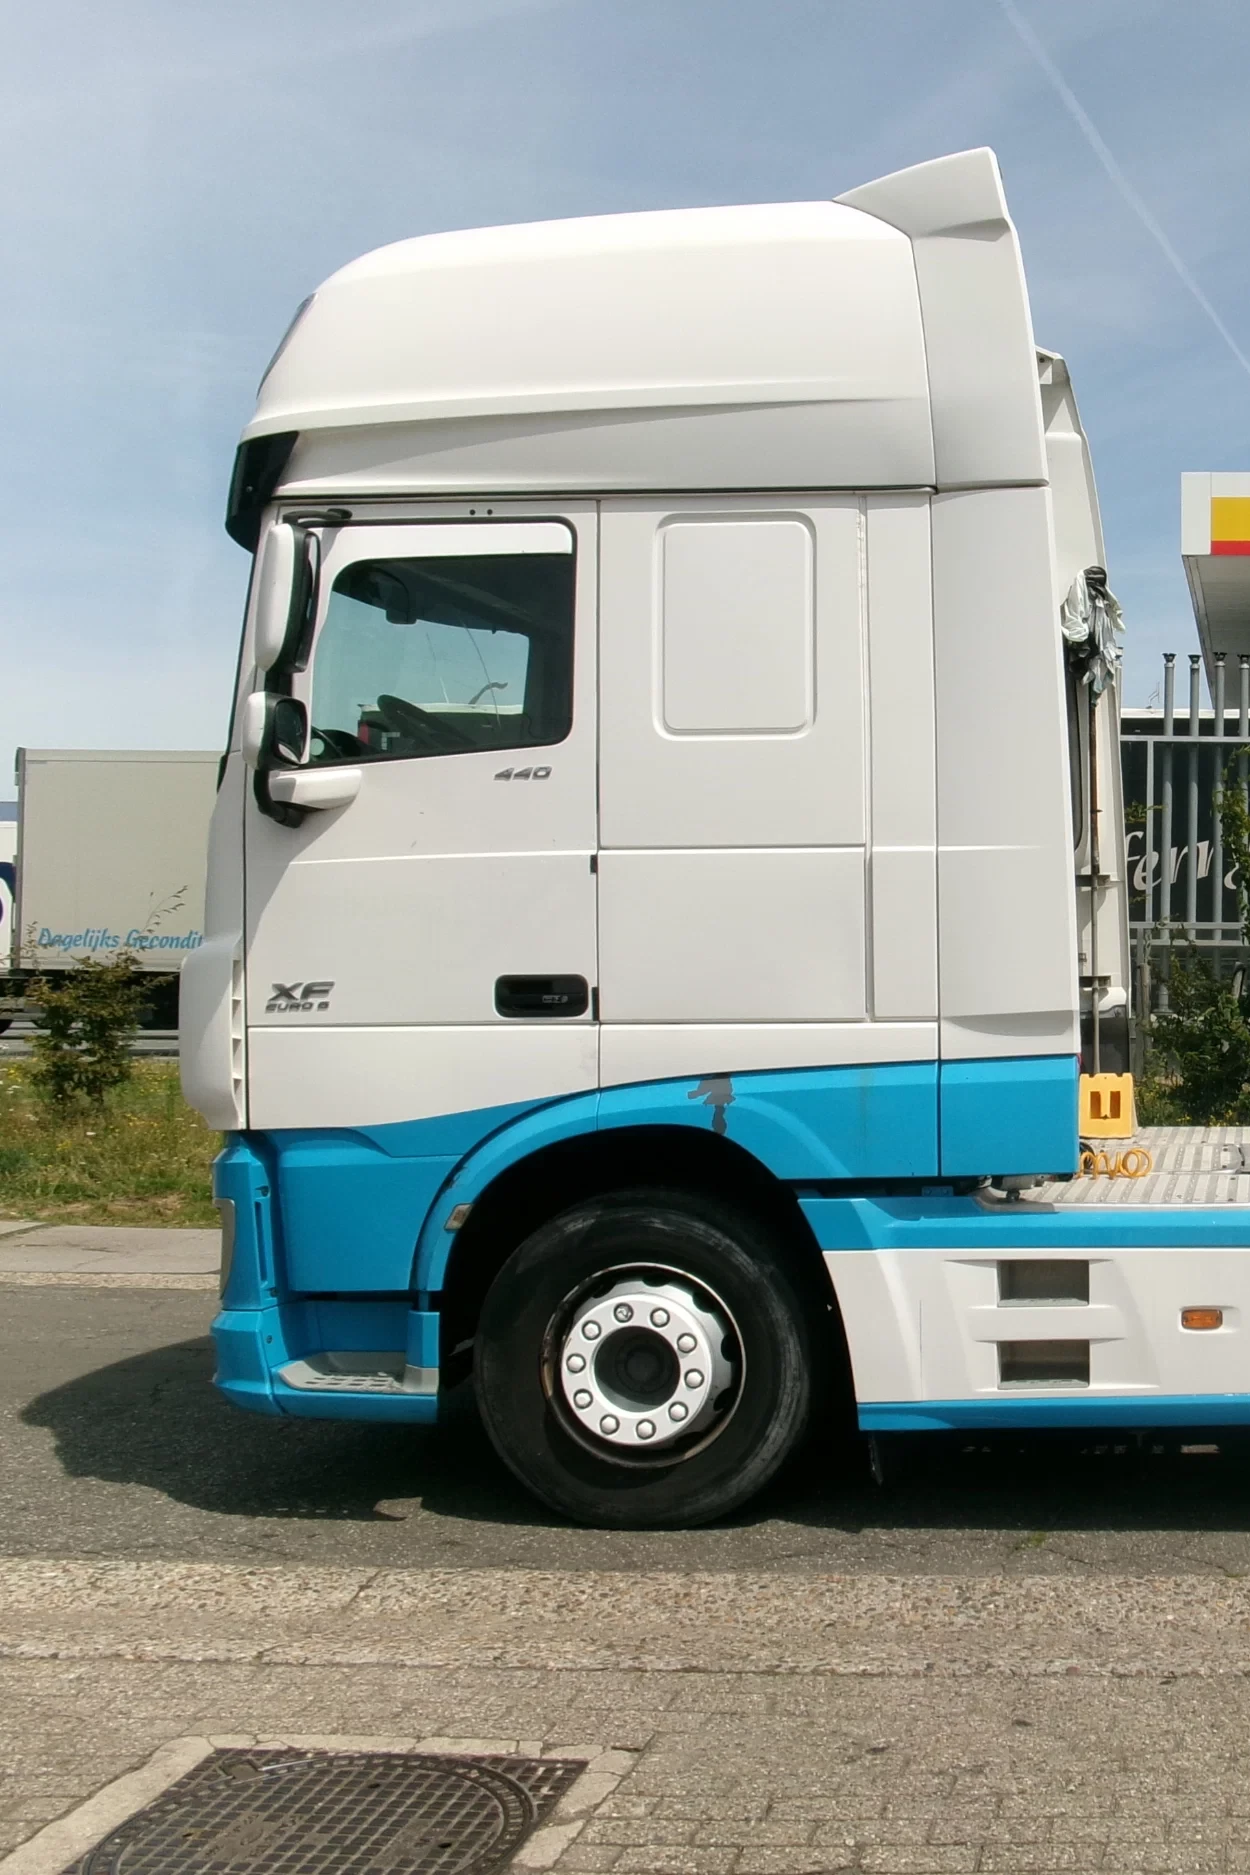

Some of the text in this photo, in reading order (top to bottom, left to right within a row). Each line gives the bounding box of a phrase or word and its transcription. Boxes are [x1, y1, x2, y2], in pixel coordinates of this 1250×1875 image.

[493, 766, 553, 781] 440
[267, 981, 335, 1001] XF
[265, 1001, 330, 1014] EURO 6
